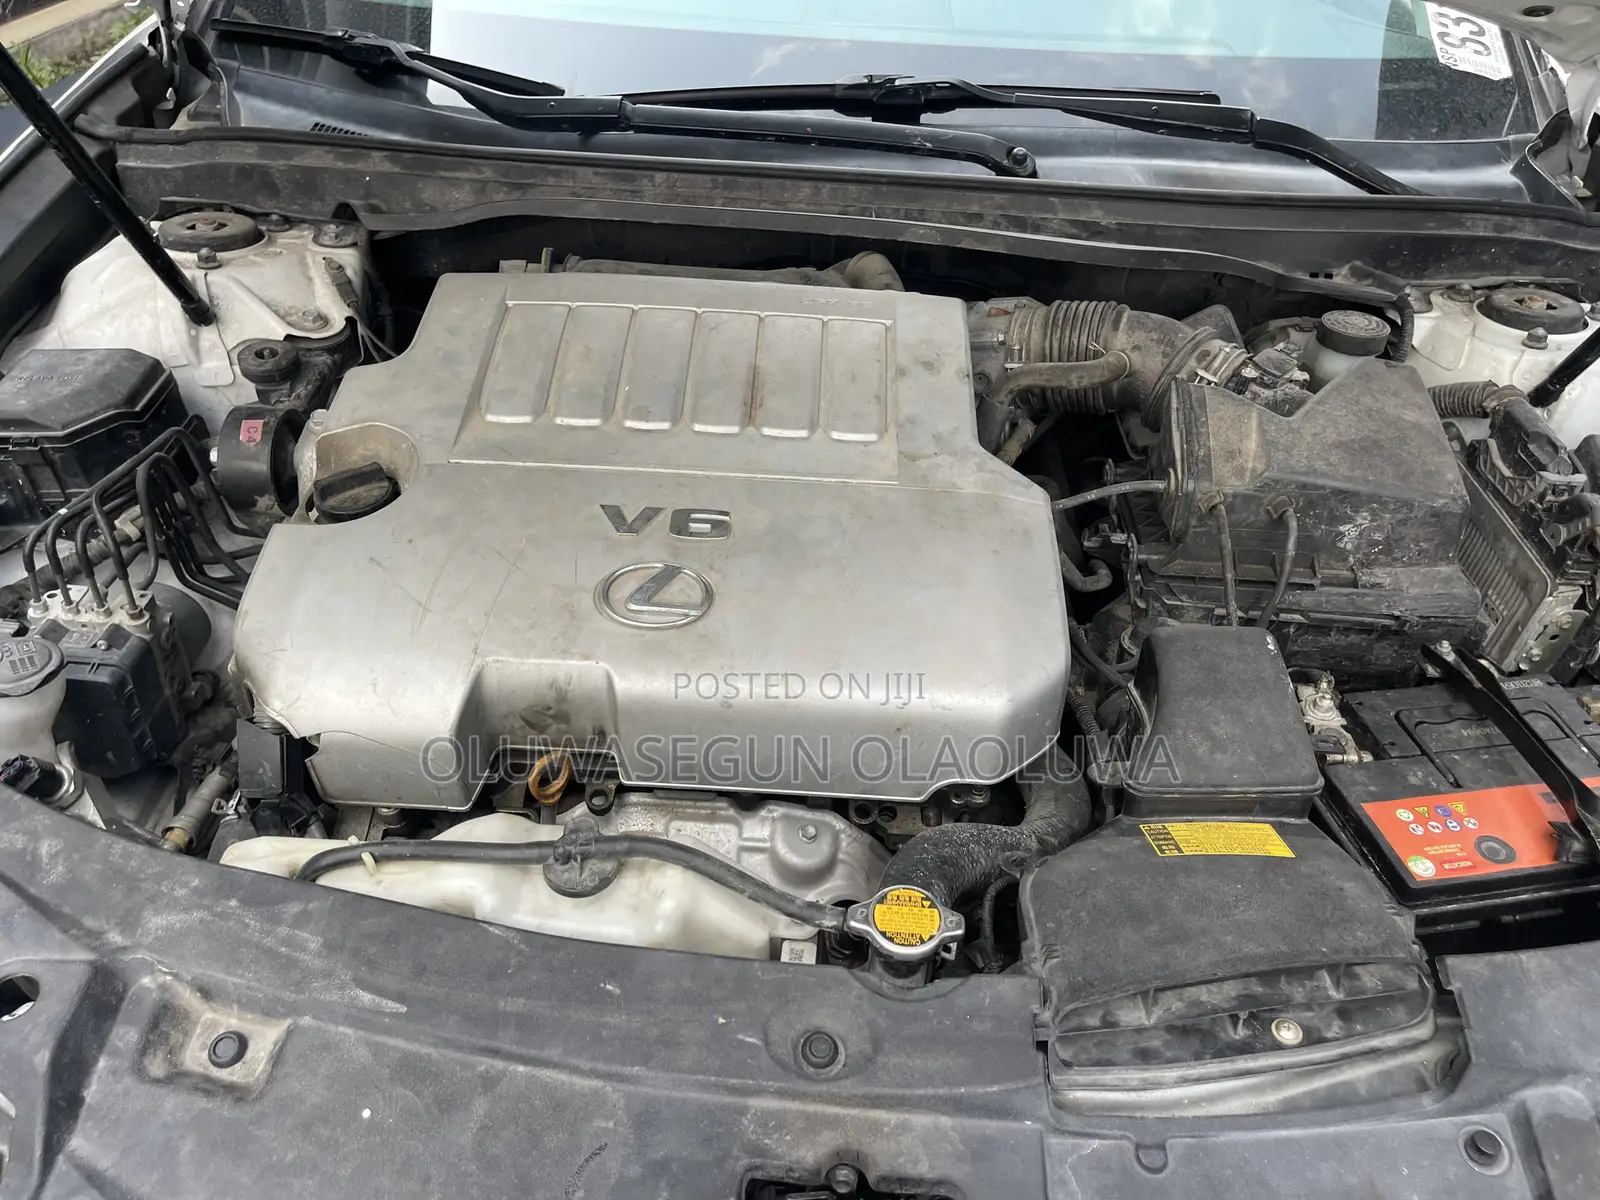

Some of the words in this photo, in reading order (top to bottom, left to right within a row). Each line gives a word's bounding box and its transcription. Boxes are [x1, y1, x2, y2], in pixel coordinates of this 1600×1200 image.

[600, 504, 732, 541] V6
[886, 931, 921, 940] ATTENTION
[894, 936, 921, 946] CAUTION
